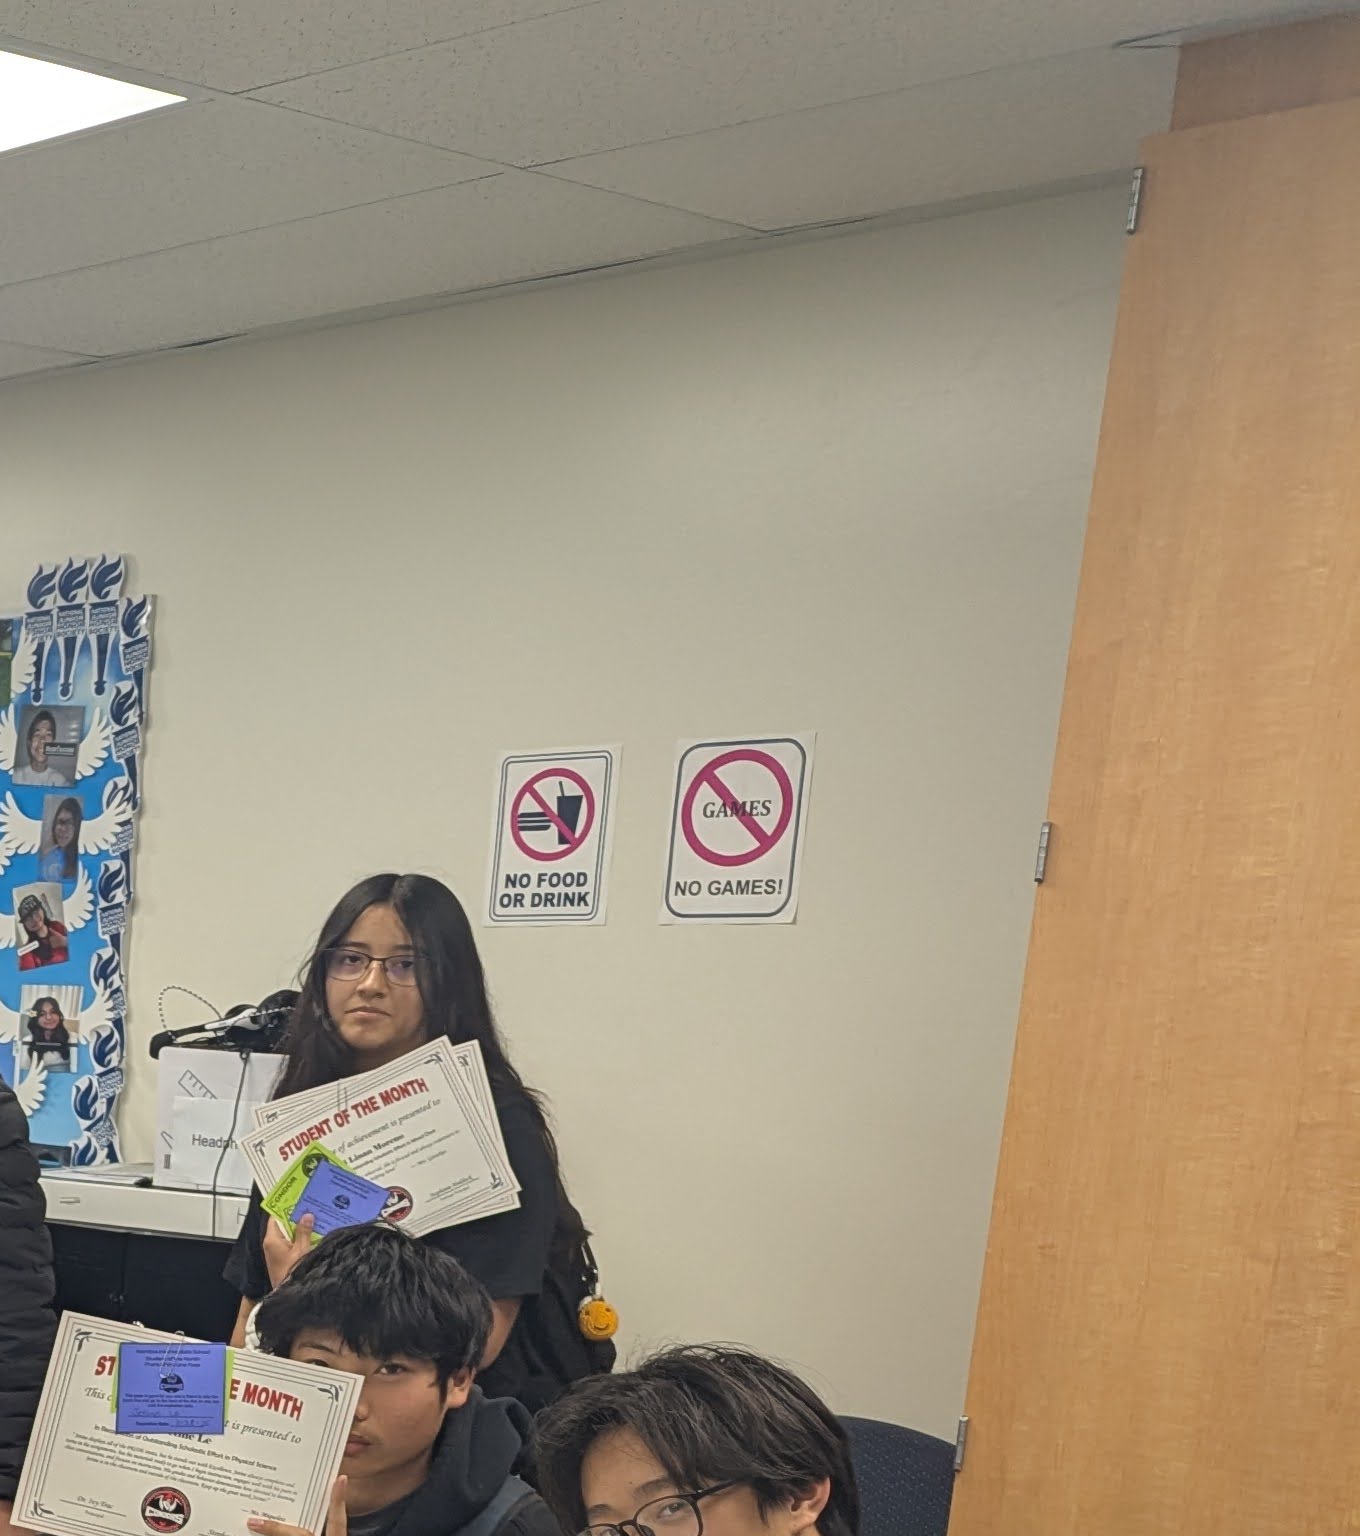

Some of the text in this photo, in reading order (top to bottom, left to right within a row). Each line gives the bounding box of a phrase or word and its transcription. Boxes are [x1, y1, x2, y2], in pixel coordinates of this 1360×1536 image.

[703, 799, 772, 818] GAMES
[504, 872, 588, 889] NO FOOD
[674, 879, 783, 897] NO GAMES!
[499, 891, 590, 909] OR DRINK
[278, 1077, 429, 1162] STUDENT OF THE MONTH
[84, 1387, 105, 1402] This
[241, 1382, 304, 1421] MONTH
[241, 1421, 291, 1444] presented
[292, 1434, 302, 1444] to
